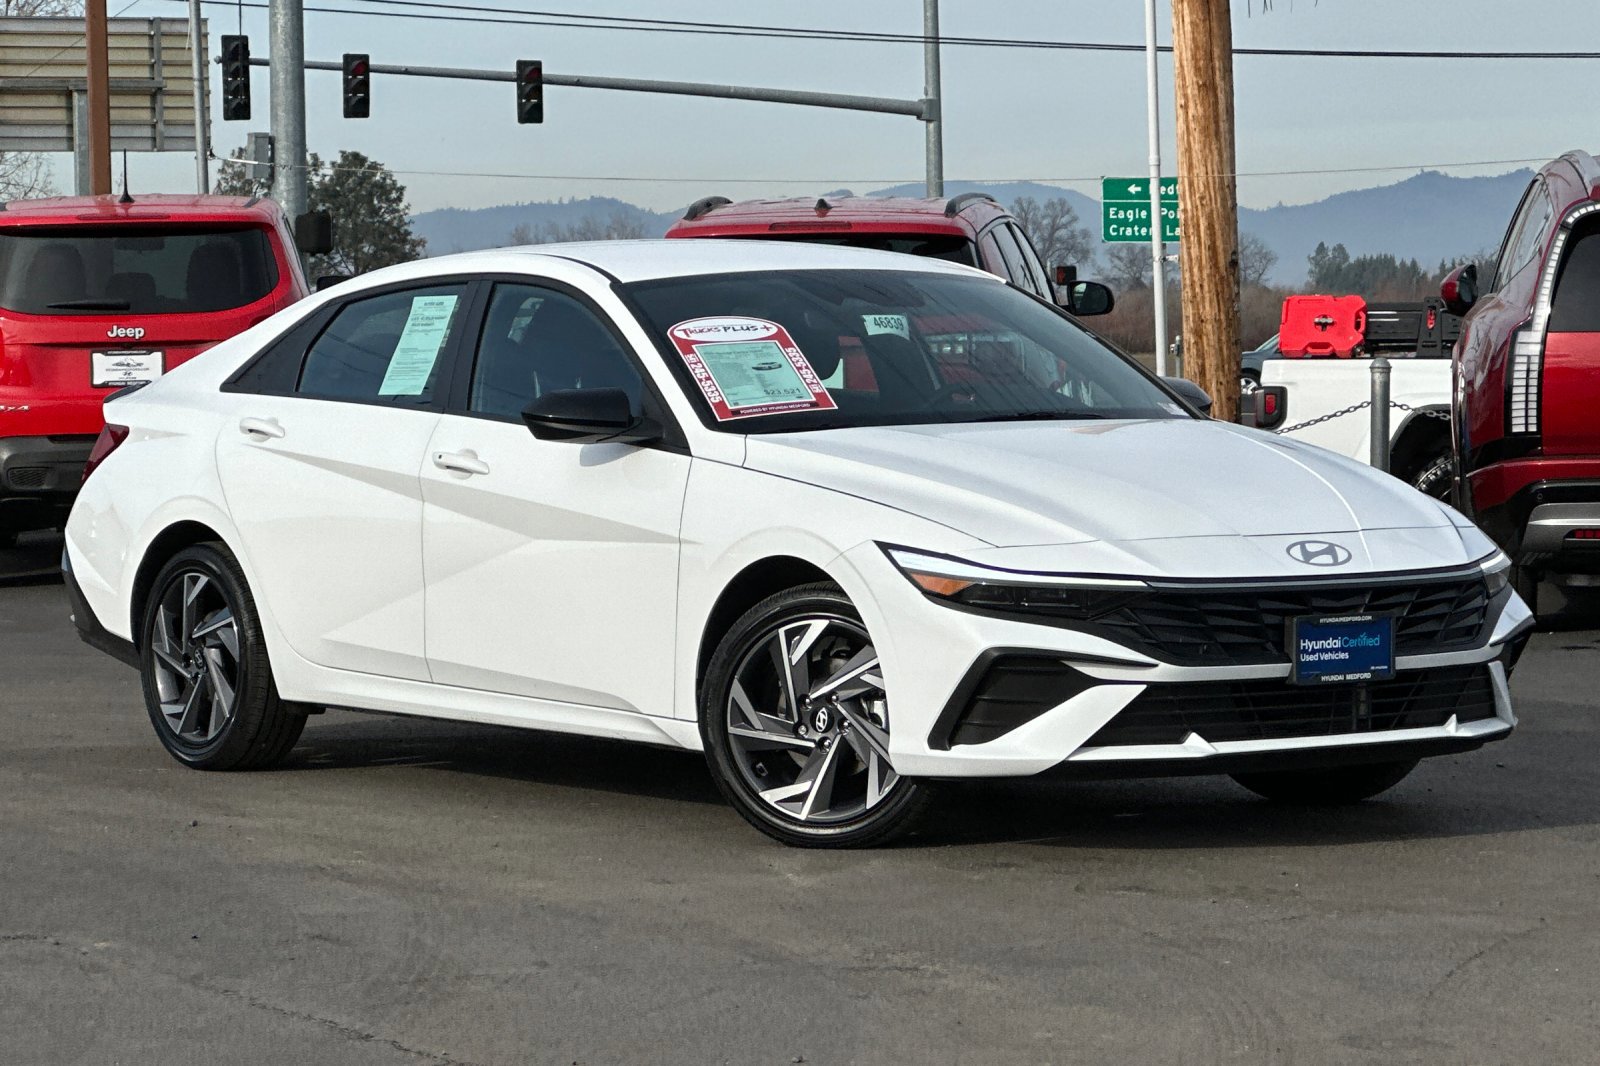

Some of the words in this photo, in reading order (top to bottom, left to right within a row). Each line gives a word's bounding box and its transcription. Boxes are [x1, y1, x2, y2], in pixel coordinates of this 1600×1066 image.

[1109, 207, 1147, 222] Eagle
[873, 316, 904, 331] 46839
[107, 325, 145, 339] Jeep
[785, 347, 817, 385] 245-5335
[690, 363, 722, 403] 245-5335
[1319, 615, 1373, 624] HYUNDAIMEDFORD.COM
[1300, 636, 1341, 651] Hyundai
[1341, 632, 1380, 648] Certified
[1300, 652, 1319, 662] Used
[1319, 650, 1349, 661] Vehicles
[1321, 673, 1344, 682] HYUNDAI
[1345, 672, 1371, 681] MEDFORD
